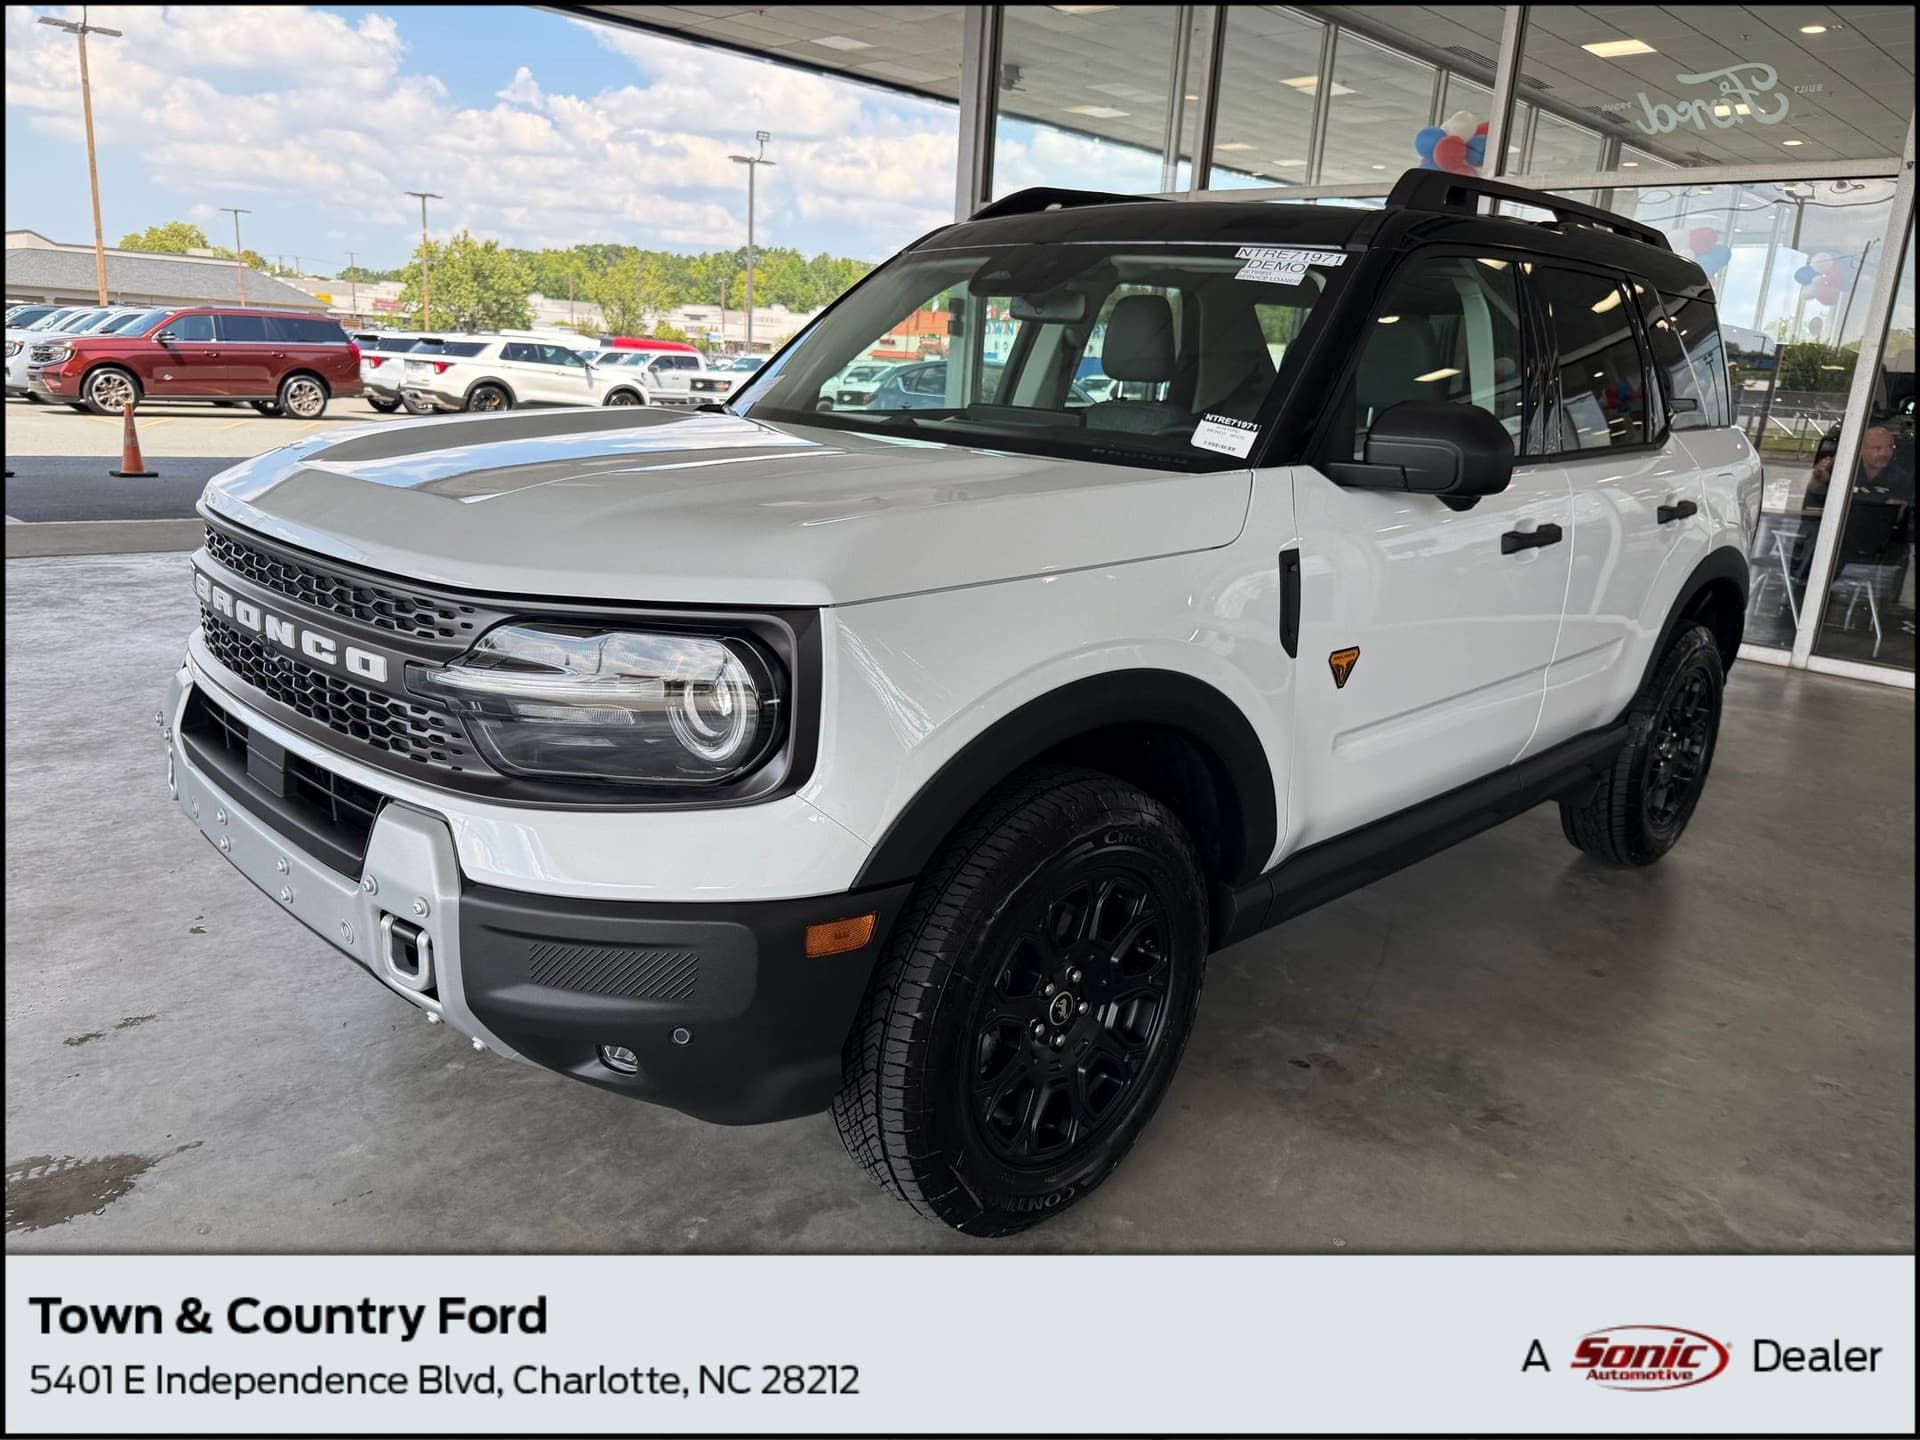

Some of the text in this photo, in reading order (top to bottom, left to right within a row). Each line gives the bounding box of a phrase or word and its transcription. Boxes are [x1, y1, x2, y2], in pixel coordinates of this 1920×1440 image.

[1238, 248, 1342, 265] NTRE71971
[1247, 260, 1306, 273] DEMO
[1205, 413, 1258, 431] NTRE71971
[195, 573, 388, 683] BRONCO
